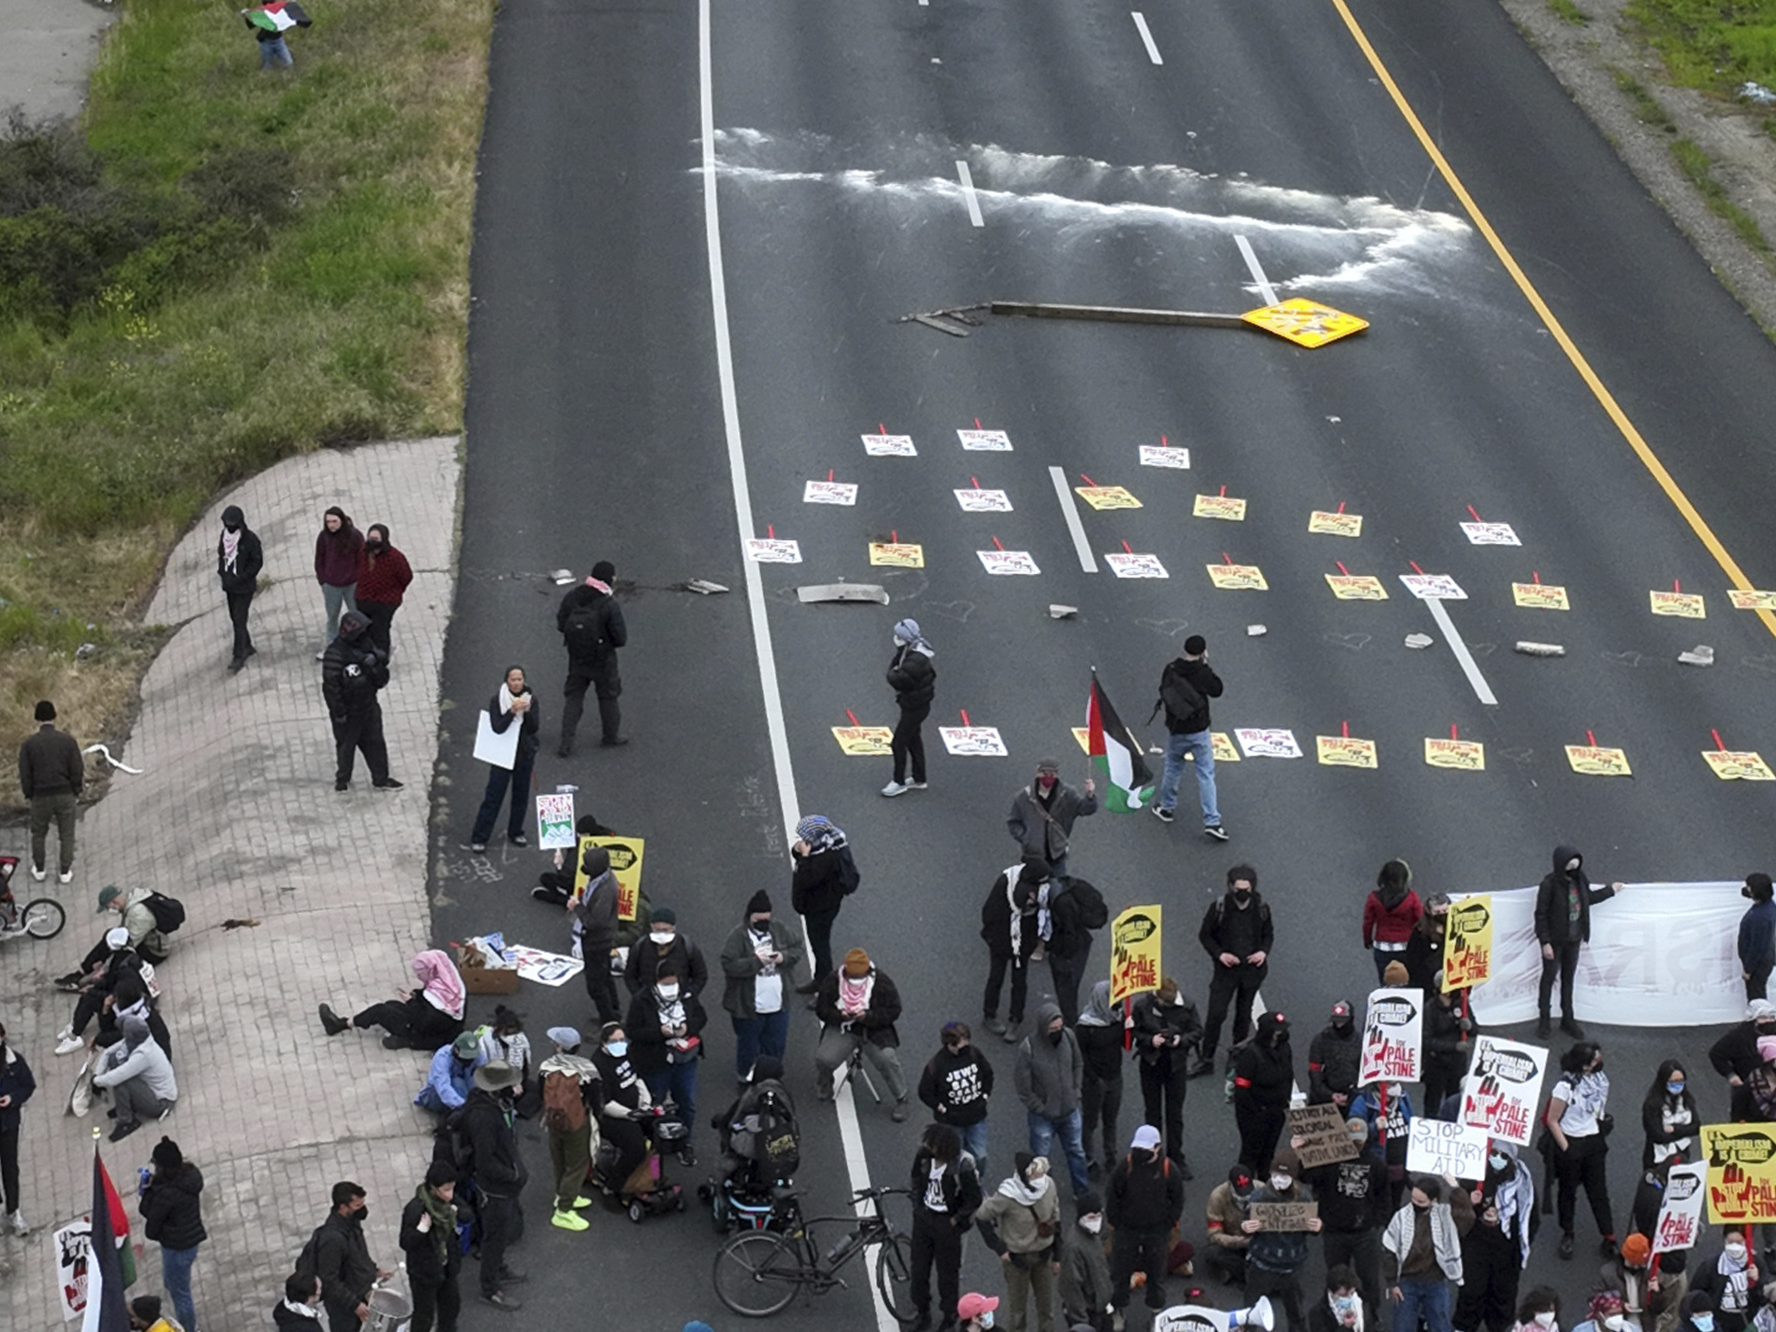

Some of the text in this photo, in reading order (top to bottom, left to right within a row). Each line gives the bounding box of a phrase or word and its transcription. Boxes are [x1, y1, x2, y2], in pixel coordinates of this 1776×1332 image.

[1129, 959, 1156, 975] PALE
[1129, 973, 1157, 989] STINE
[1387, 1046, 1416, 1062] PALE
[946, 1063, 979, 1083] JEWS
[1384, 1061, 1415, 1078] STINE
[1502, 1103, 1530, 1124] PALE
[1416, 1119, 1464, 1140] STOP
[1494, 1119, 1527, 1141] STINE
[1432, 1157, 1466, 1175] AID
